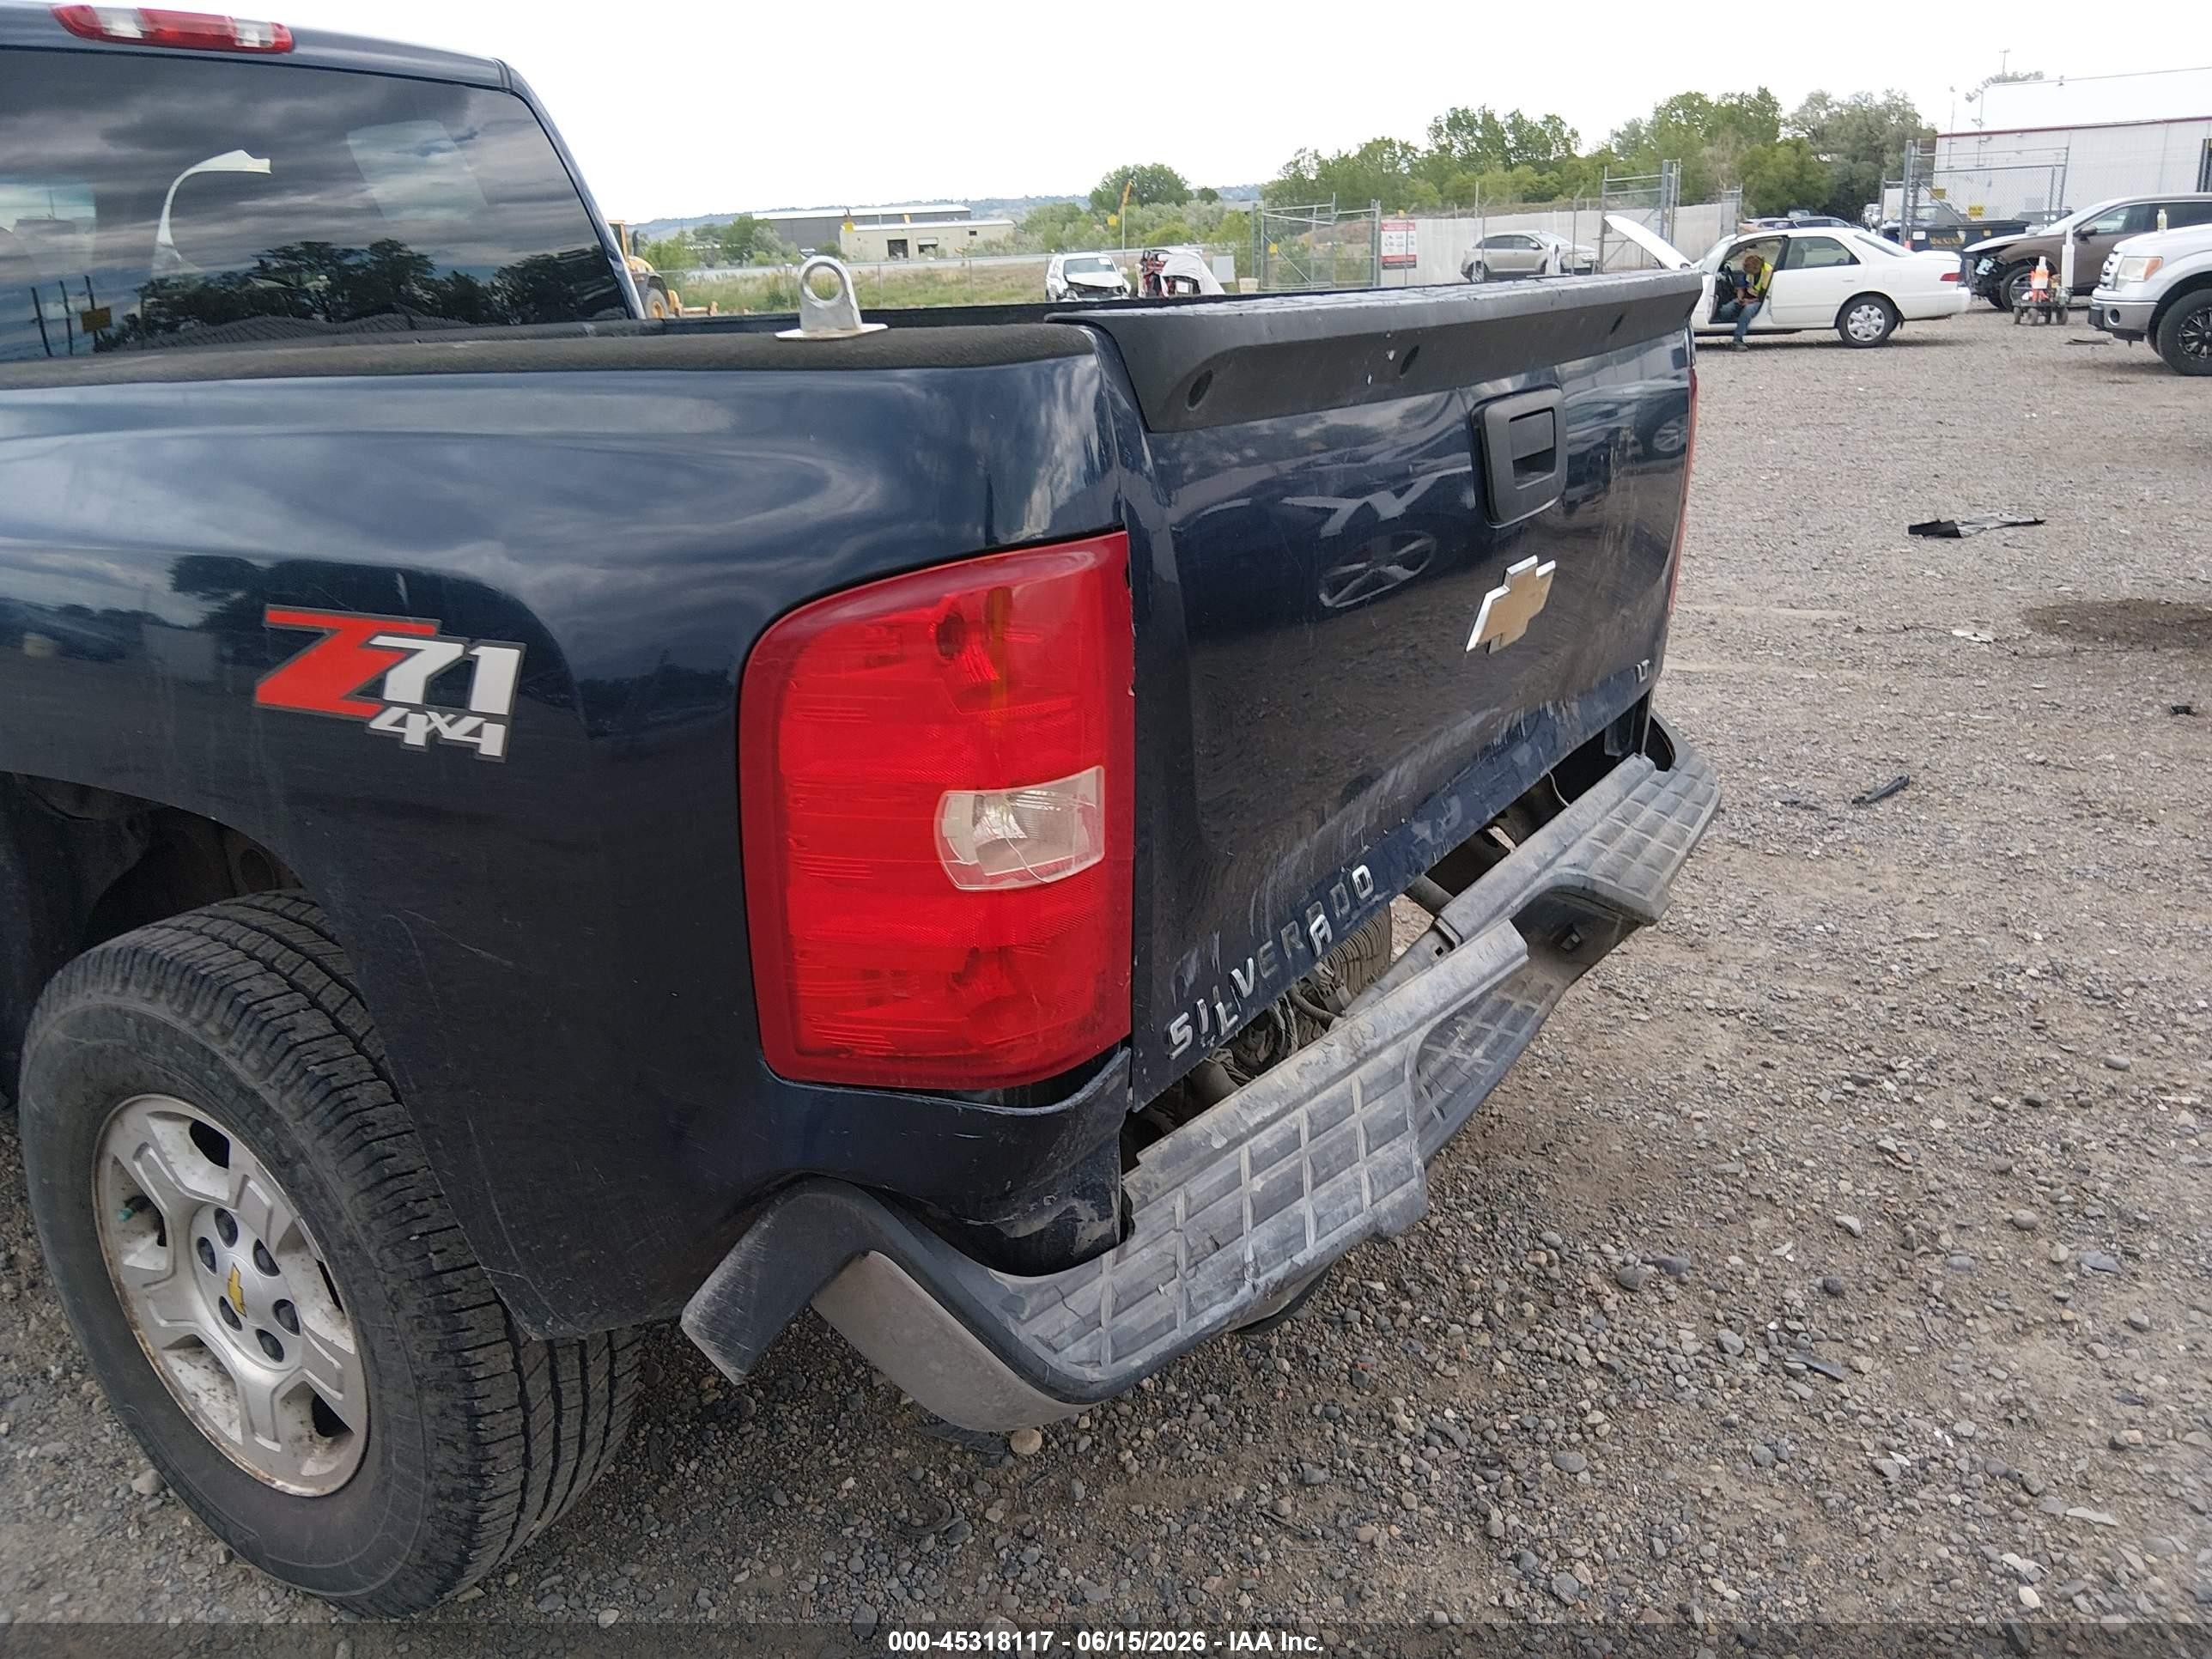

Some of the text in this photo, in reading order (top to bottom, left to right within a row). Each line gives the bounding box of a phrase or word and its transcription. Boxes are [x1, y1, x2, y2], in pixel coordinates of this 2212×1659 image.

[256, 605, 526, 718] Z71
[1636, 659, 1650, 683] LT
[1168, 864, 1374, 1060] SILVERADO
